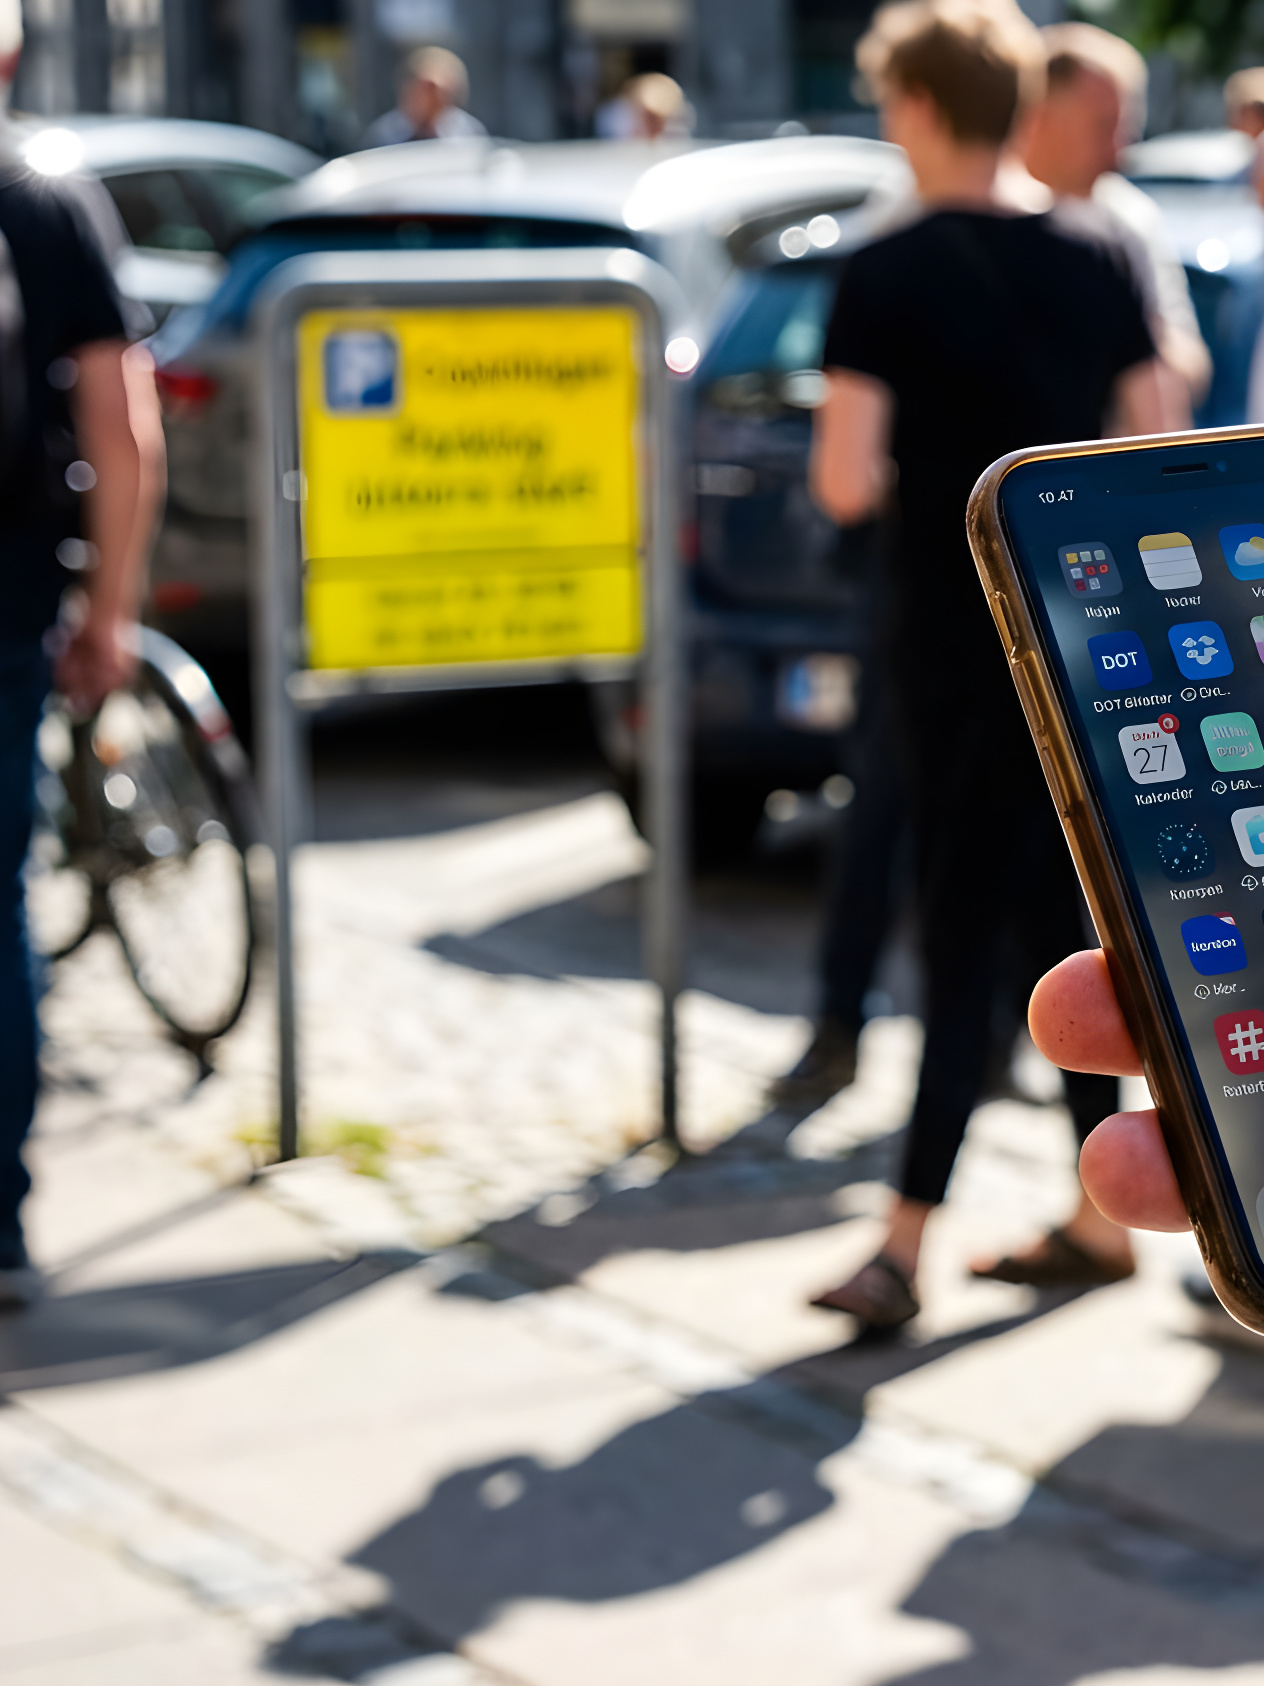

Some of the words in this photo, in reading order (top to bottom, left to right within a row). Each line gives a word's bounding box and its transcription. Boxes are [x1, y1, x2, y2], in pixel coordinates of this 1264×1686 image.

[1101, 651, 1138, 670] DOT
[1093, 699, 1121, 713] DOT
[1133, 744, 1168, 775] 27
